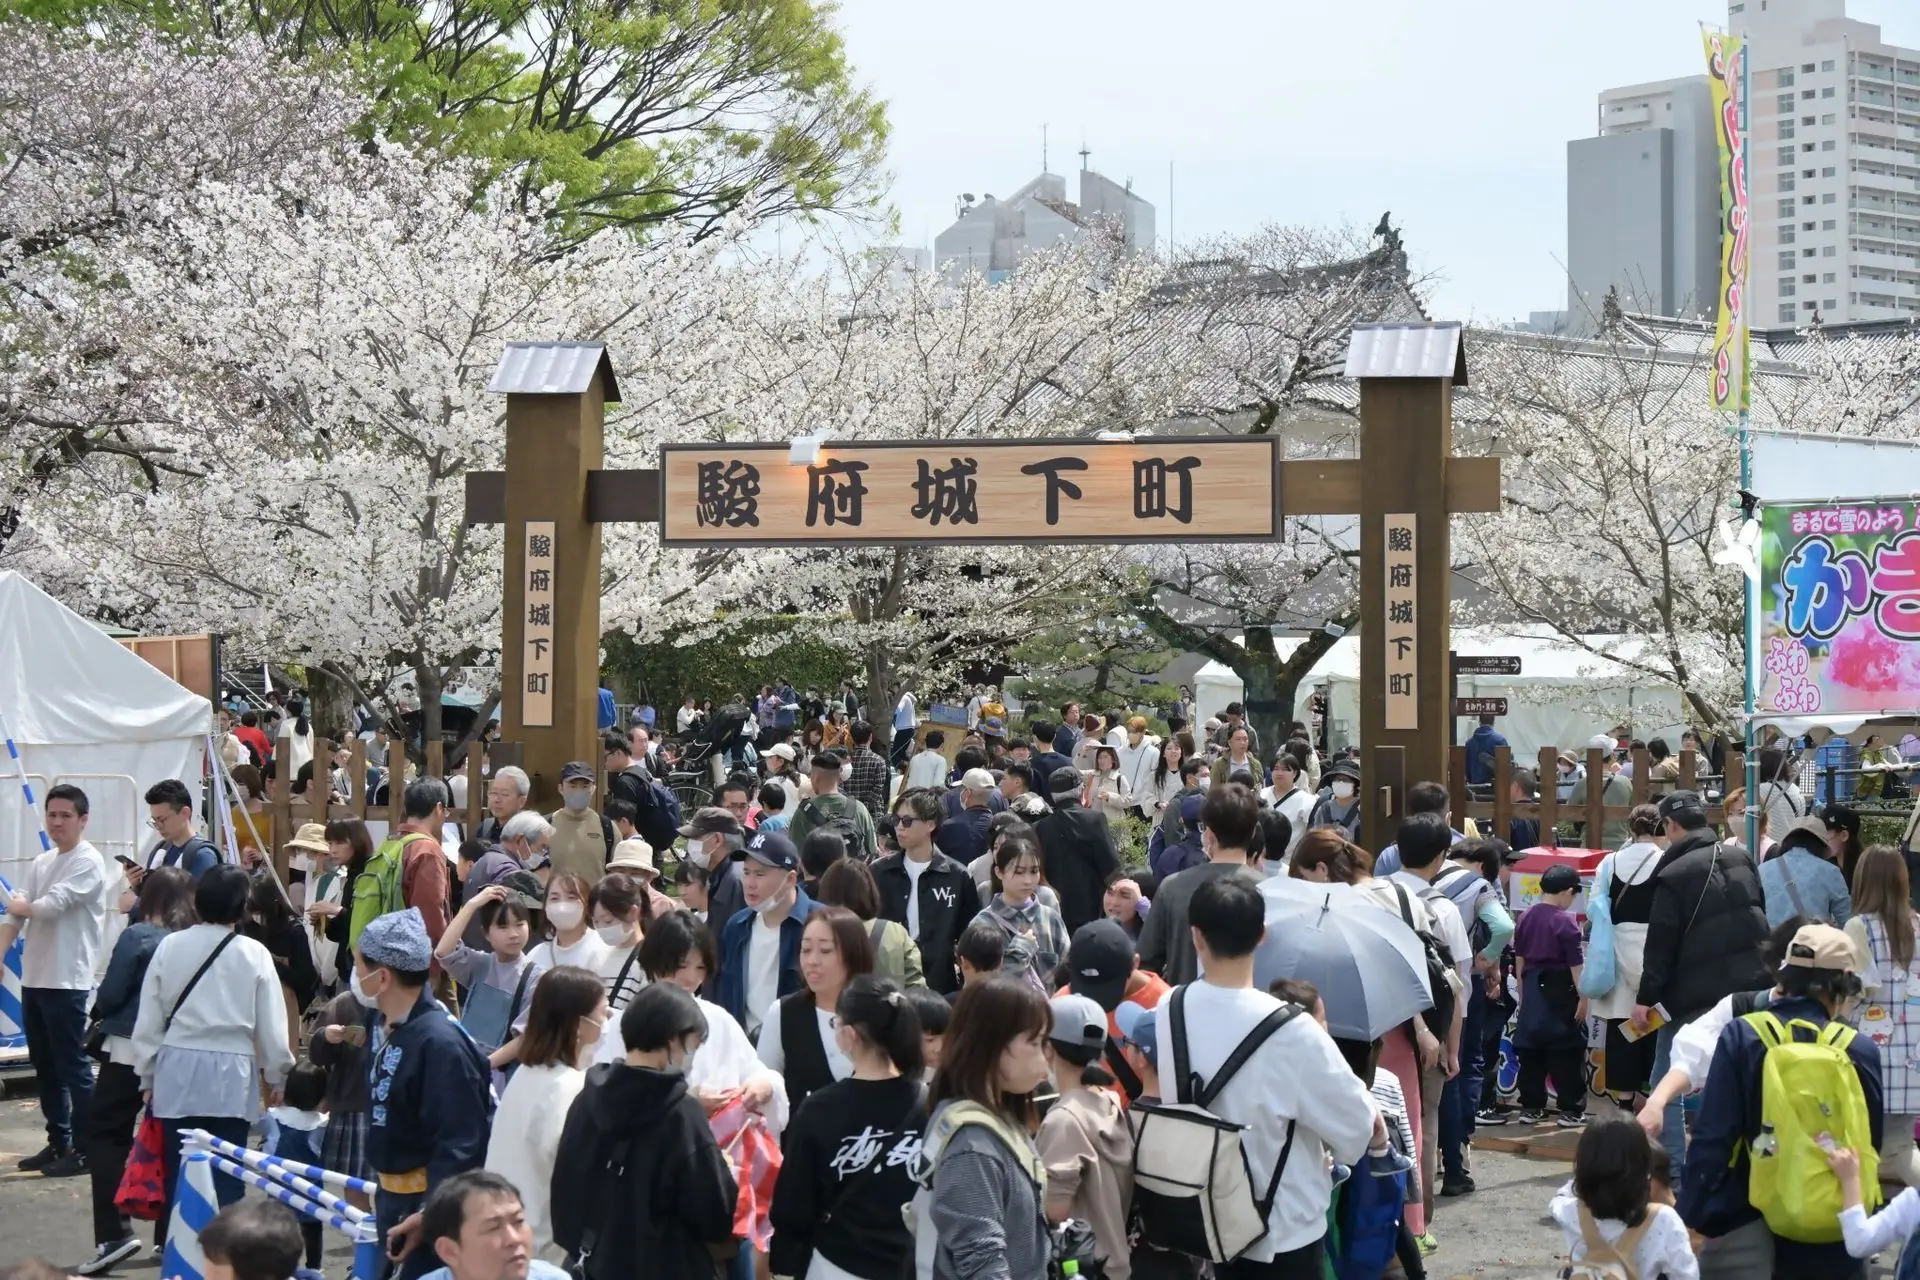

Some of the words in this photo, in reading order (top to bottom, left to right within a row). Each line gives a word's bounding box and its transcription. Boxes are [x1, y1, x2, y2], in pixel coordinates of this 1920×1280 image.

[696, 457, 1202, 528] 駿府城下町
[1791, 508, 1904, 533] まるで雪のよう
[527, 535, 551, 695] 駿府城下町
[1388, 527, 1413, 696] 駿府城下町
[1766, 639, 1808, 676] ふわ
[1774, 678, 1821, 712] ふわ
[931, 886, 956, 908] WT
